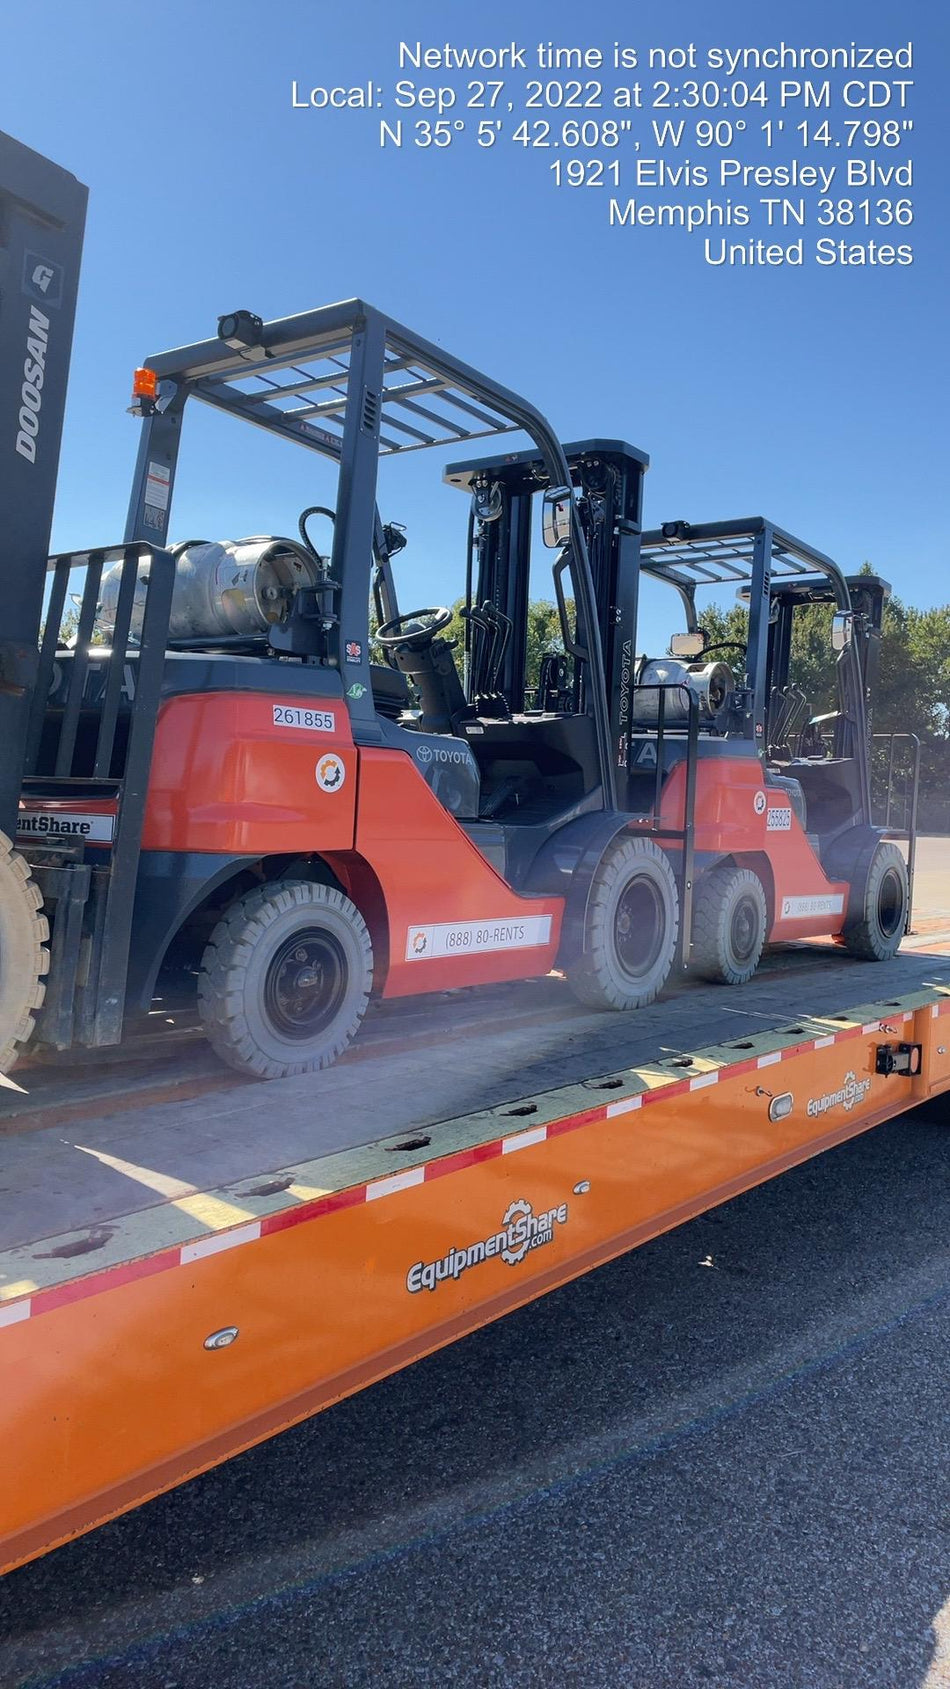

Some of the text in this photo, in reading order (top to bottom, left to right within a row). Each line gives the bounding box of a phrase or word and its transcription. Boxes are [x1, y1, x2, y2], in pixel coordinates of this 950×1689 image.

[15, 304, 51, 465] DOOSAN
[618, 639, 632, 726] TOYOTA
[273, 707, 333, 730] 261855
[433, 749, 473, 765] TOYOTA
[445, 925, 525, 950] (888) 80-RENTS
[807, 1079, 871, 1117] EquipmentShare
[406, 1203, 568, 1293] EquipmentShare
[529, 1229, 554, 1249] .com
